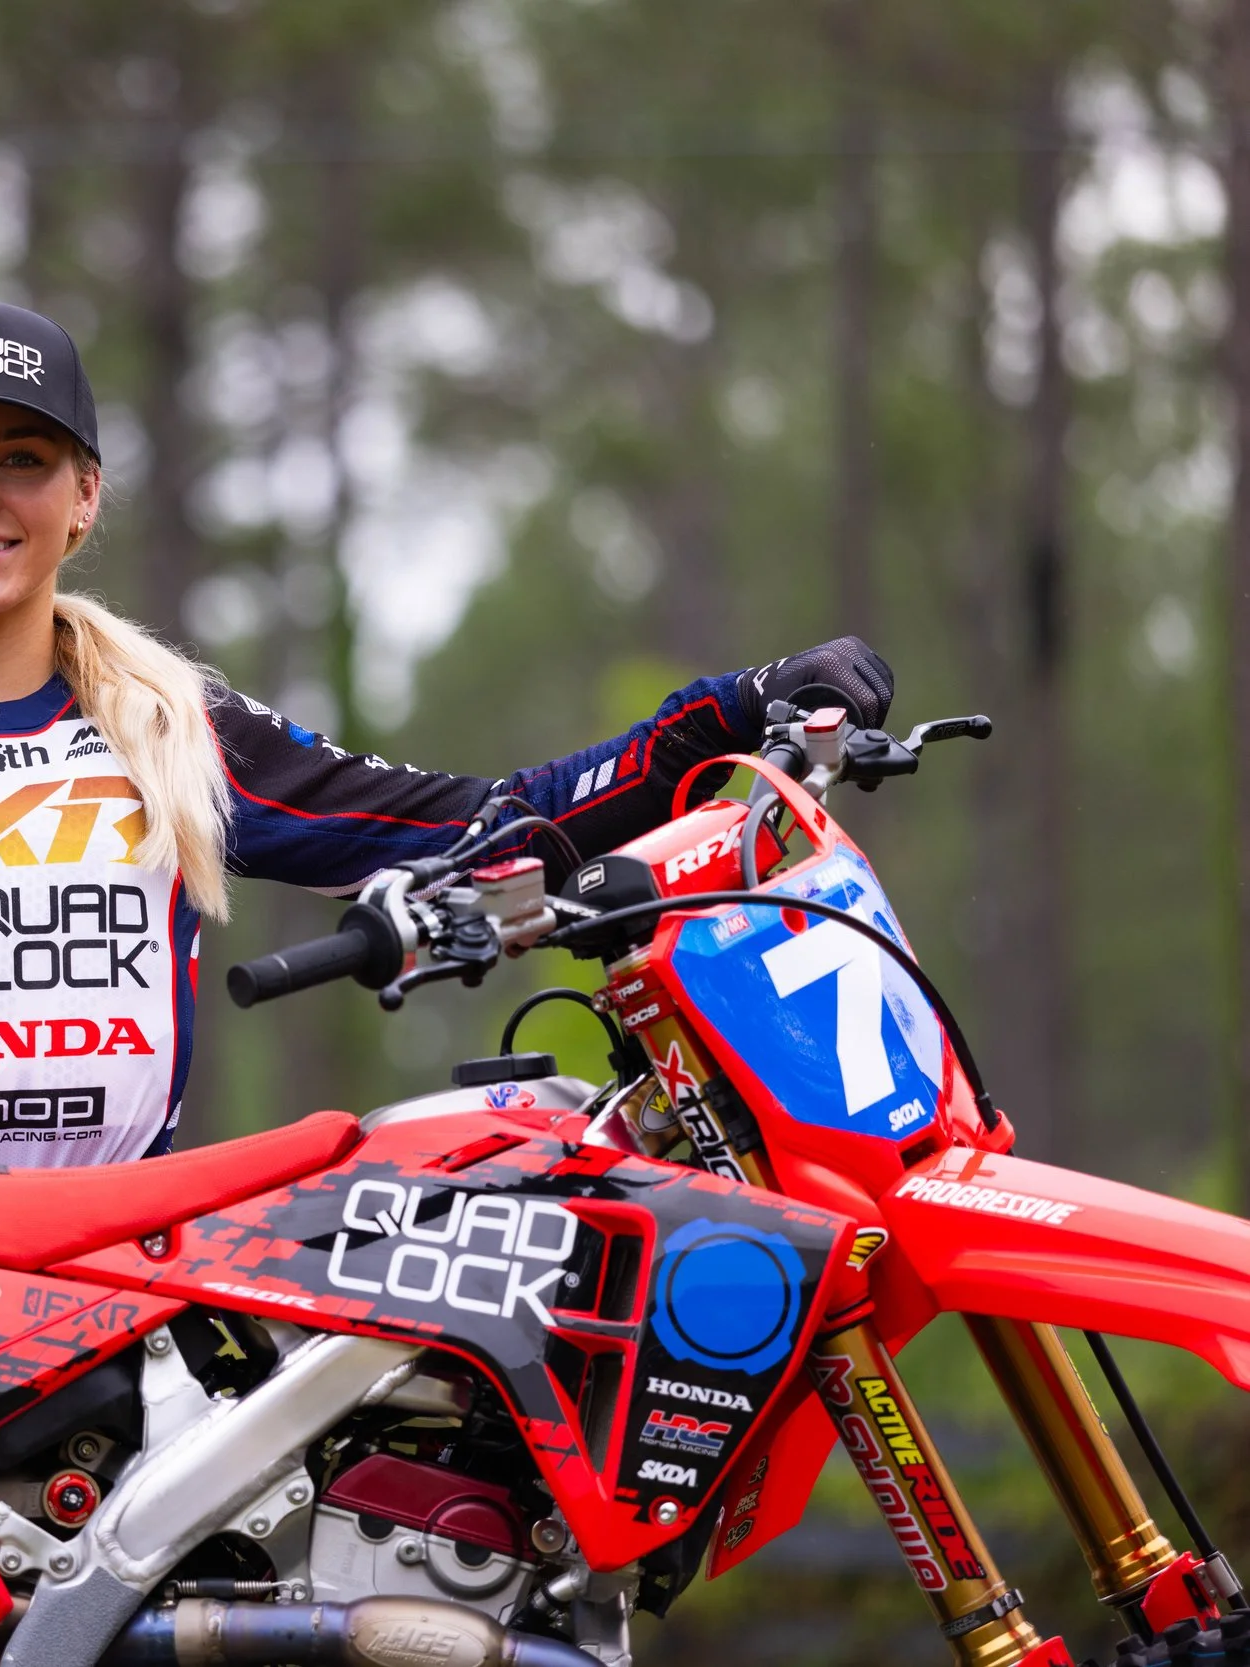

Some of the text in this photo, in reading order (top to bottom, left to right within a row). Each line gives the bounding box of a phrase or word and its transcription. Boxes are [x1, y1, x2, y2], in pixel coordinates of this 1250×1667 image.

[760, 902, 897, 1117] 7
[485, 1081, 520, 1109] VP
[889, 1099, 926, 1131] SKDA
[895, 1176, 1083, 1225] PROGRESSIVE
[341, 1179, 578, 1264] QUAD
[201, 1281, 317, 1312] 450R
[646, 1376, 753, 1412] HONDA
[641, 1408, 733, 1451] HRC
[637, 1459, 698, 1488] SKDA
